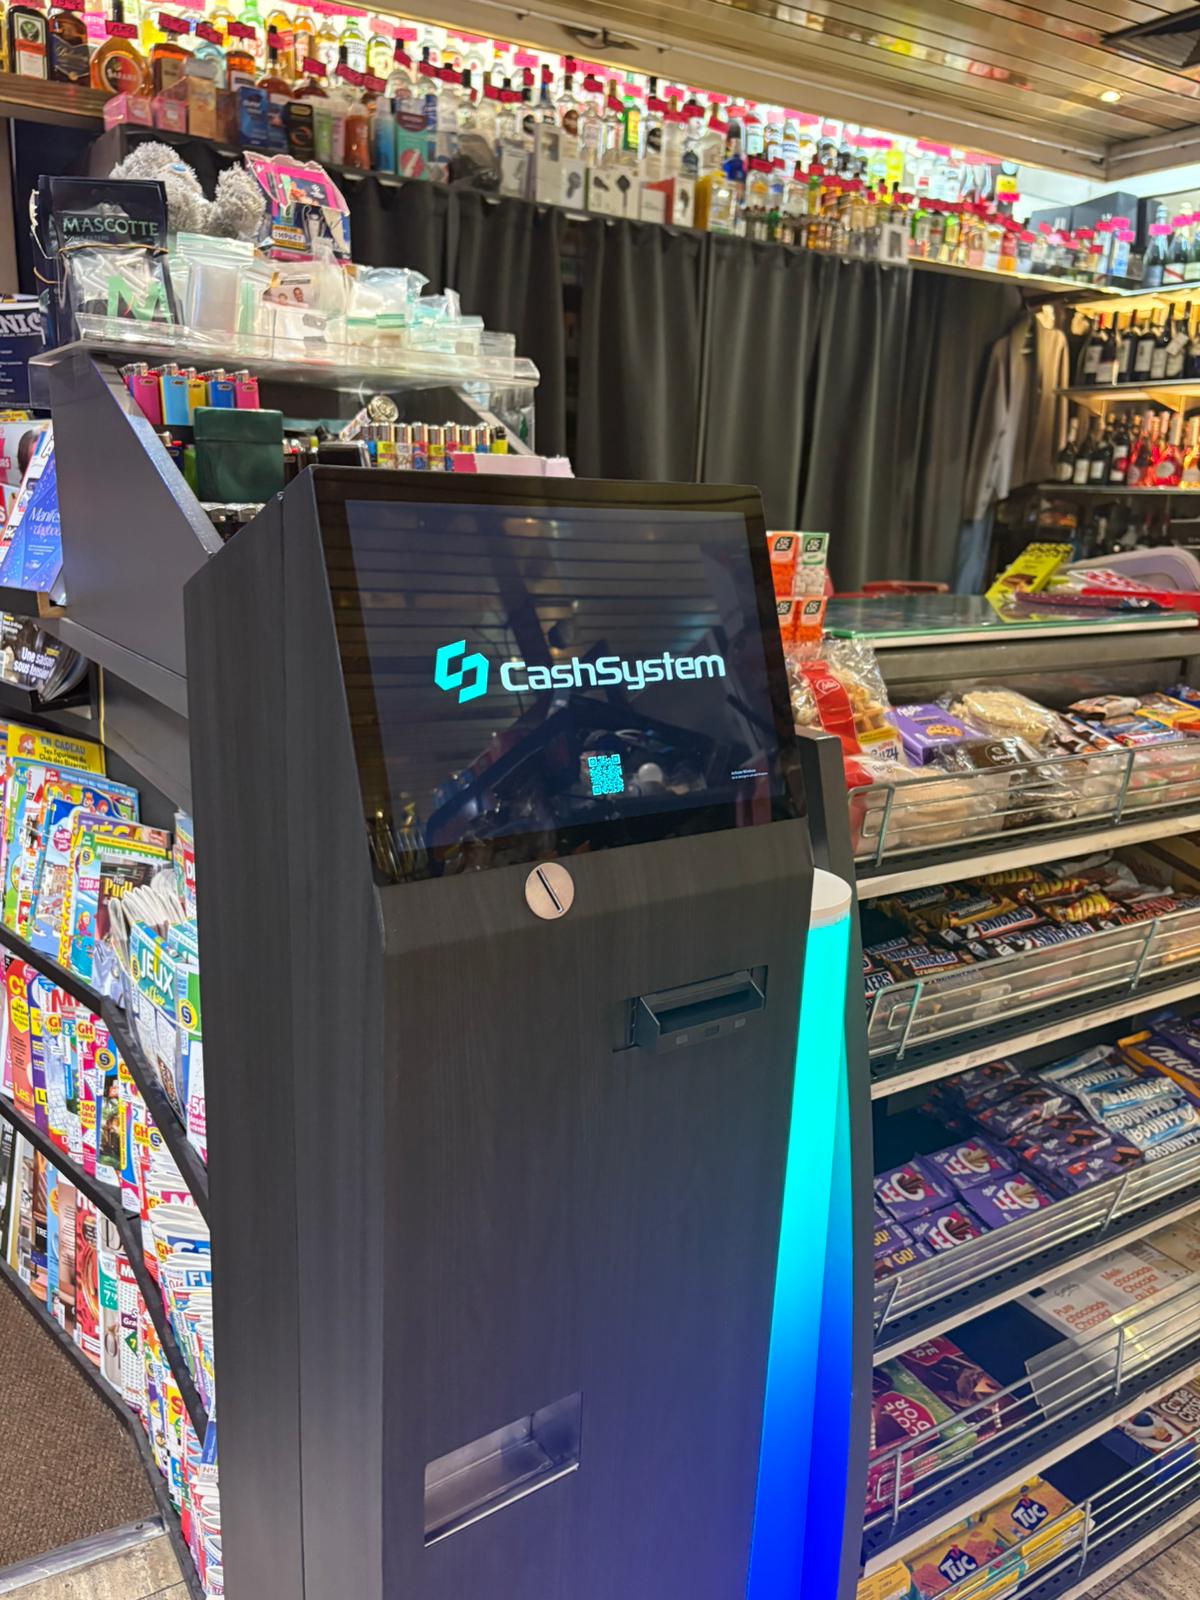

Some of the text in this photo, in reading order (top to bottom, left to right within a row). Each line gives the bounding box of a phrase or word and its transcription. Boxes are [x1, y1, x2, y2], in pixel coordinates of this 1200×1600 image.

[63, 216, 160, 237] MASCOTTE
[500, 651, 726, 692] CashSystem
[911, 952, 957, 969] SNICKERS
[140, 948, 175, 1001] JEUX
[1130, 1111, 1180, 1141] BOUNTY
[1011, 1502, 1047, 1528] TUC
[940, 1556, 977, 1581] TUC
